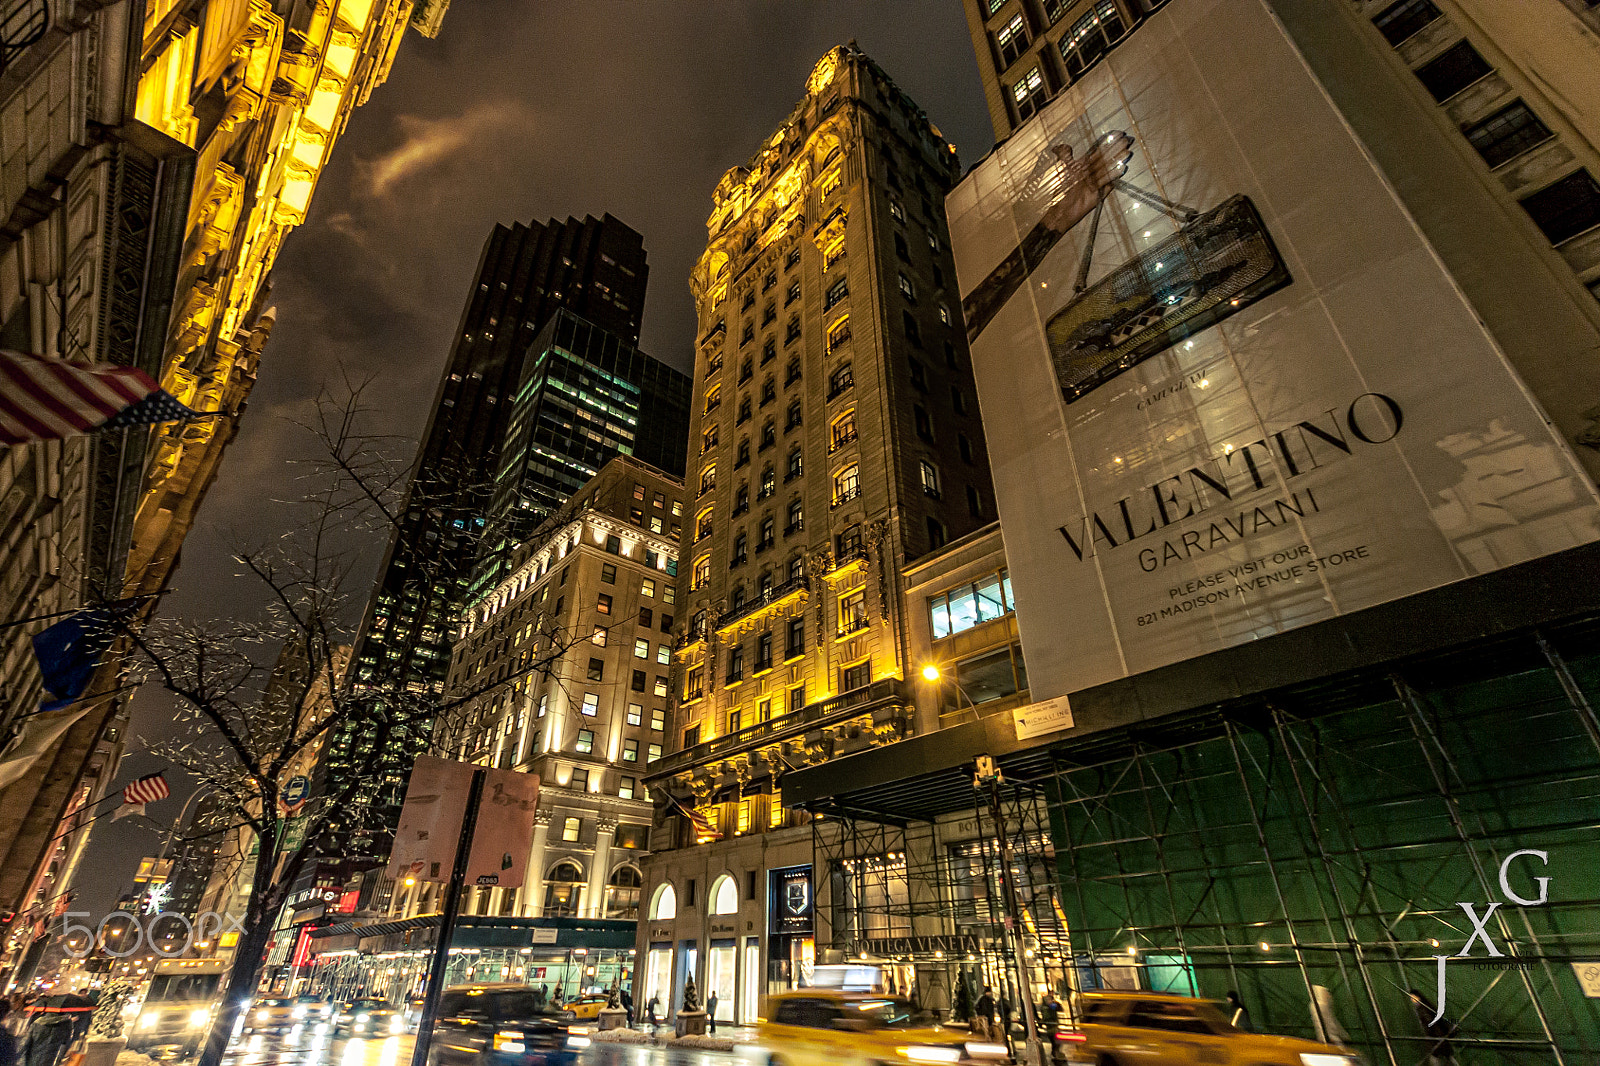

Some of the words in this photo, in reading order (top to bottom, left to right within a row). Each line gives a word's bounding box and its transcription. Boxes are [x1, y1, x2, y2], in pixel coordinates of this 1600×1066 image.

[1056, 392, 1403, 562] VALENTINO
[1138, 488, 1320, 573] GARAVANI
[1137, 612, 1158, 627] 821
[1161, 587, 1230, 620] MADISON
[1235, 567, 1304, 599] AVENUE
[1307, 545, 1370, 573] STORE
[1169, 572, 1226, 600] PLEASE
[1229, 558, 1267, 581] VISIT
[1273, 545, 1312, 567] OUR
[853, 938, 913, 953] BOTTEGA
[917, 935, 977, 951] VENETA
